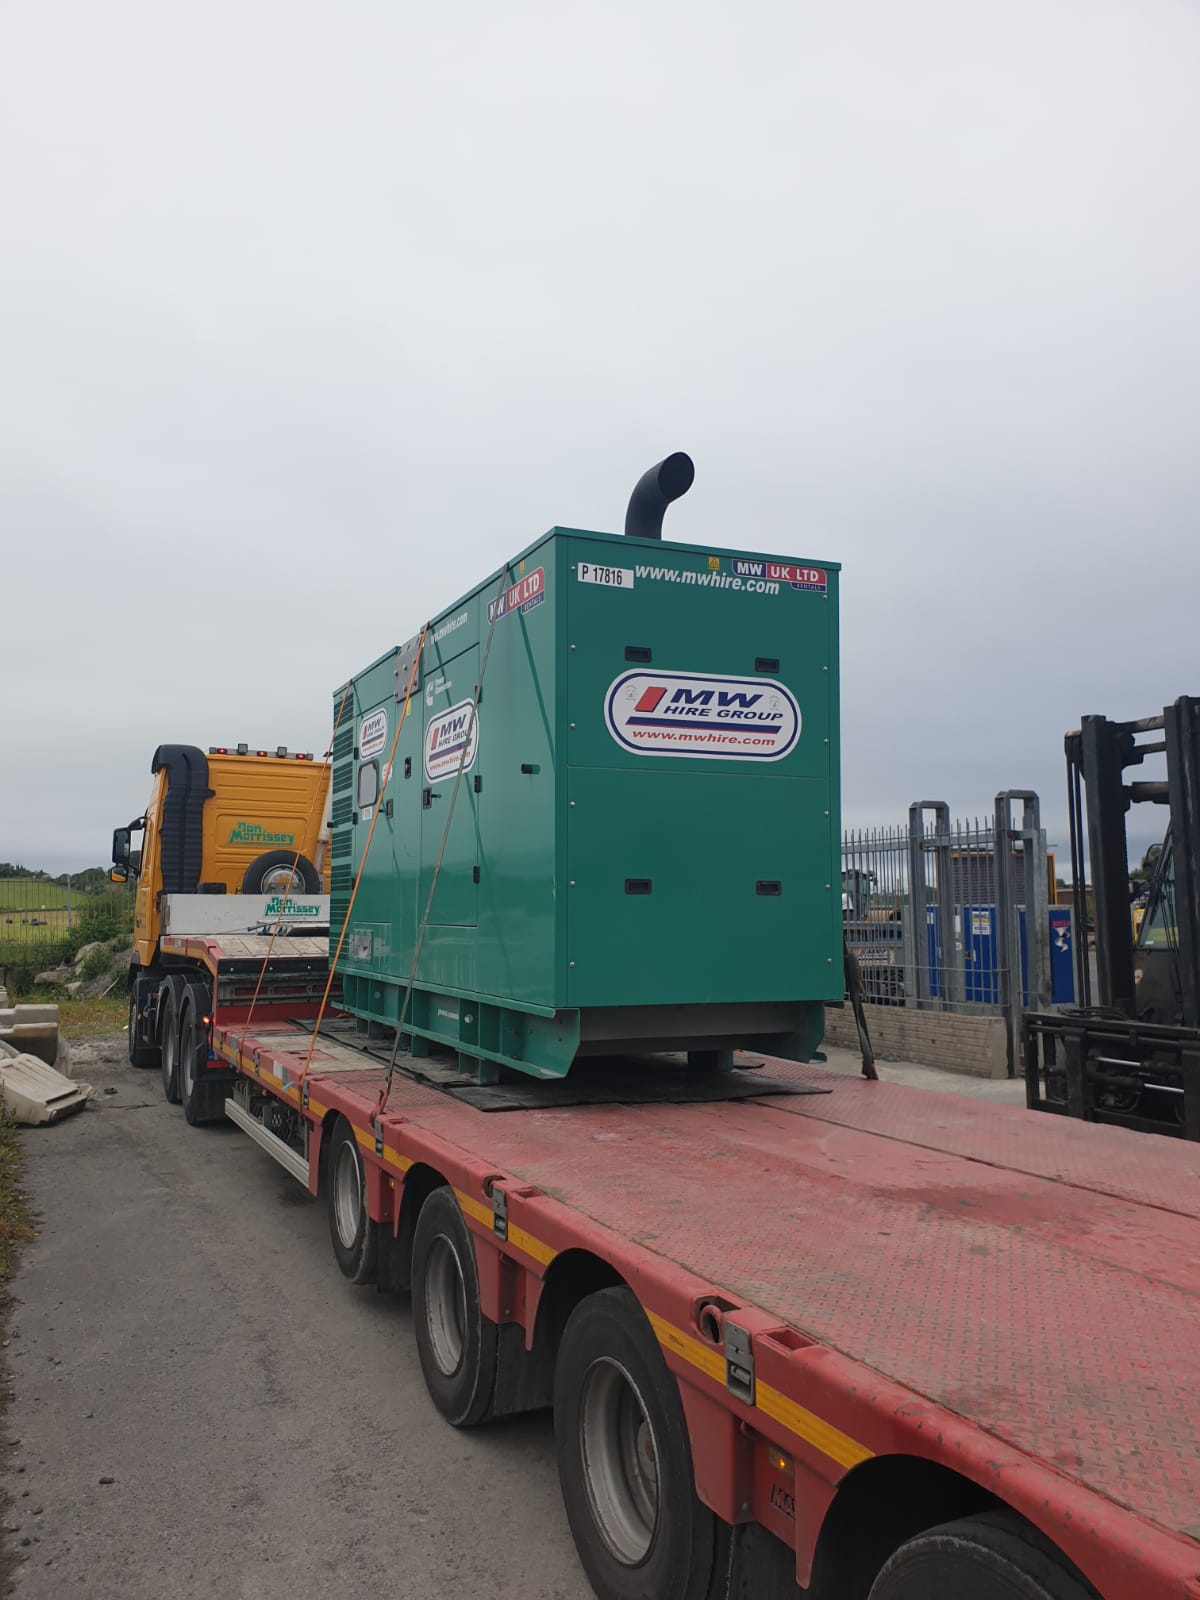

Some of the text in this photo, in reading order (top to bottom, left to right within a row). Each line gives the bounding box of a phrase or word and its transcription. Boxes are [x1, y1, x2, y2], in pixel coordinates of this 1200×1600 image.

[582, 564, 623, 586] P 17816
[635, 564, 780, 595] www.mwhire.com
[736, 561, 820, 582] MW UK LTD
[509, 585, 521, 607] UK
[523, 572, 540, 598] LTD
[670, 688, 764, 709] MW
[663, 705, 783, 721] HIRE GROUP
[440, 713, 467, 738] MW
[632, 730, 776, 747] www.mwhire.com
[229, 829, 295, 846] Morrissey
